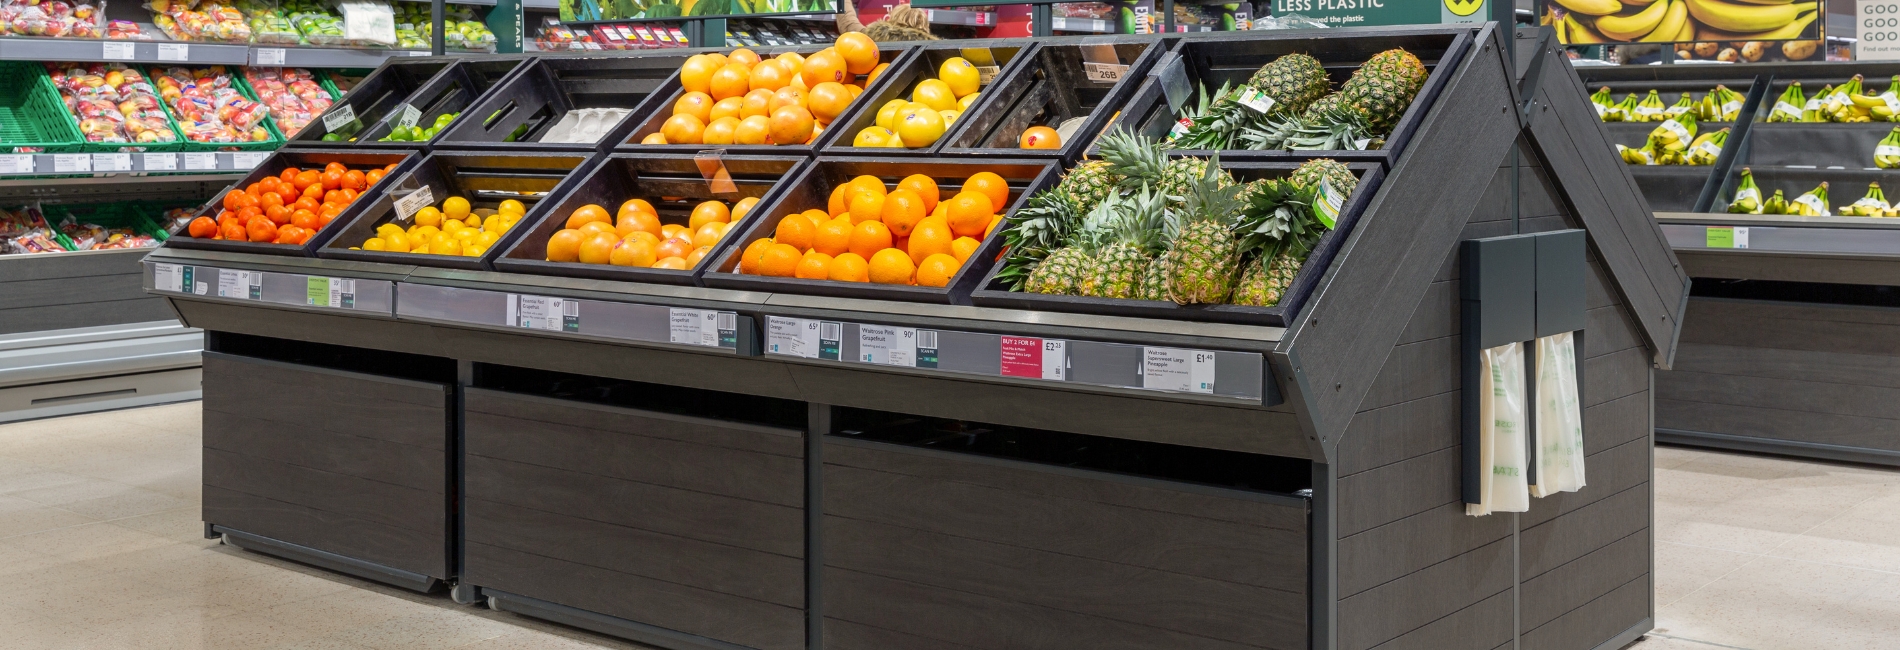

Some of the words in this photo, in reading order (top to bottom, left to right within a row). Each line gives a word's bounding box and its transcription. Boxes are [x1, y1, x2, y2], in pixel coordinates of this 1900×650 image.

[1278, 0, 1311, 12] LESS
[1318, 0, 1384, 10] PLASTIC
[1343, 15, 1364, 24] plastic
